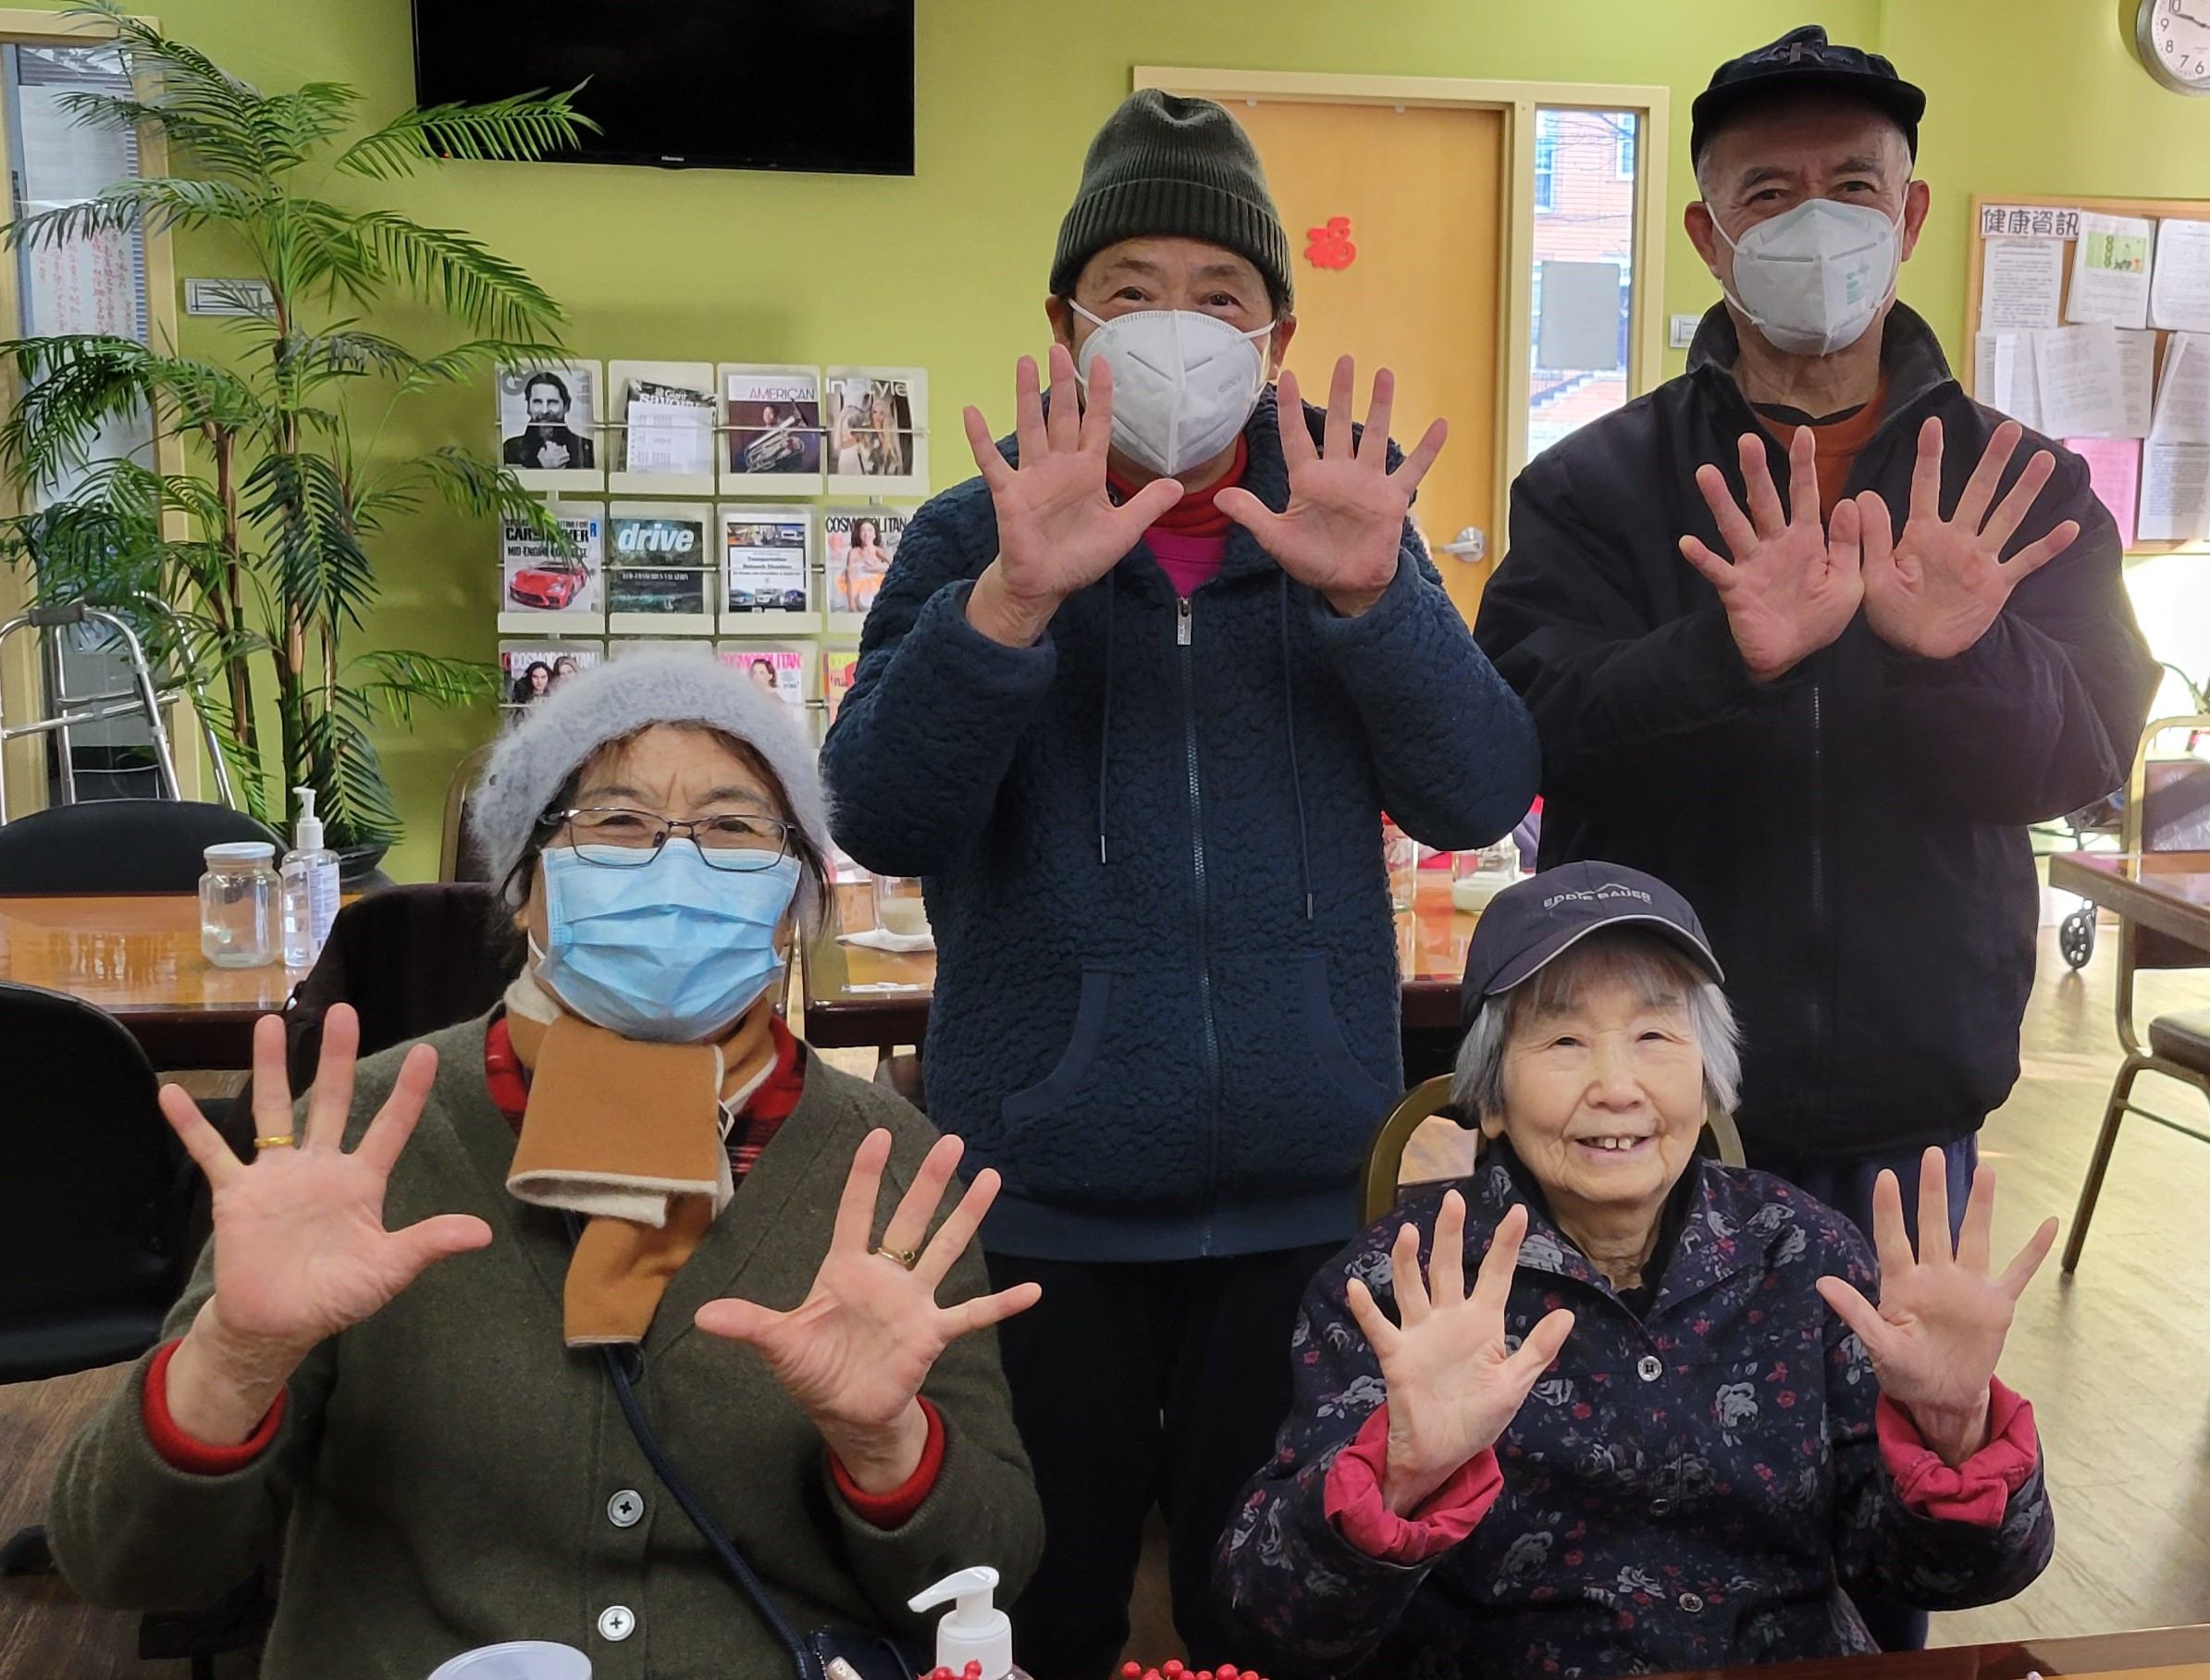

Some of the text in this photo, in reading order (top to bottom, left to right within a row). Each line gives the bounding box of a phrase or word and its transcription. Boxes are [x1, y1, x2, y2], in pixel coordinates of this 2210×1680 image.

[2168, 0, 2181, 12] 10
[2160, 18, 2169, 32] 9
[2166, 40, 2174, 54] 8
[2179, 55, 2190, 68] 7
[2194, 61, 2204, 75] 6
[1983, 208, 2080, 236] 健康資訊
[749, 388, 815, 401] AMERICAN
[826, 377, 908, 399] Intyle
[505, 527, 533, 541] CAR
[618, 523, 696, 552] drive
[1543, 889, 1653, 909] EDDIE BAUER
